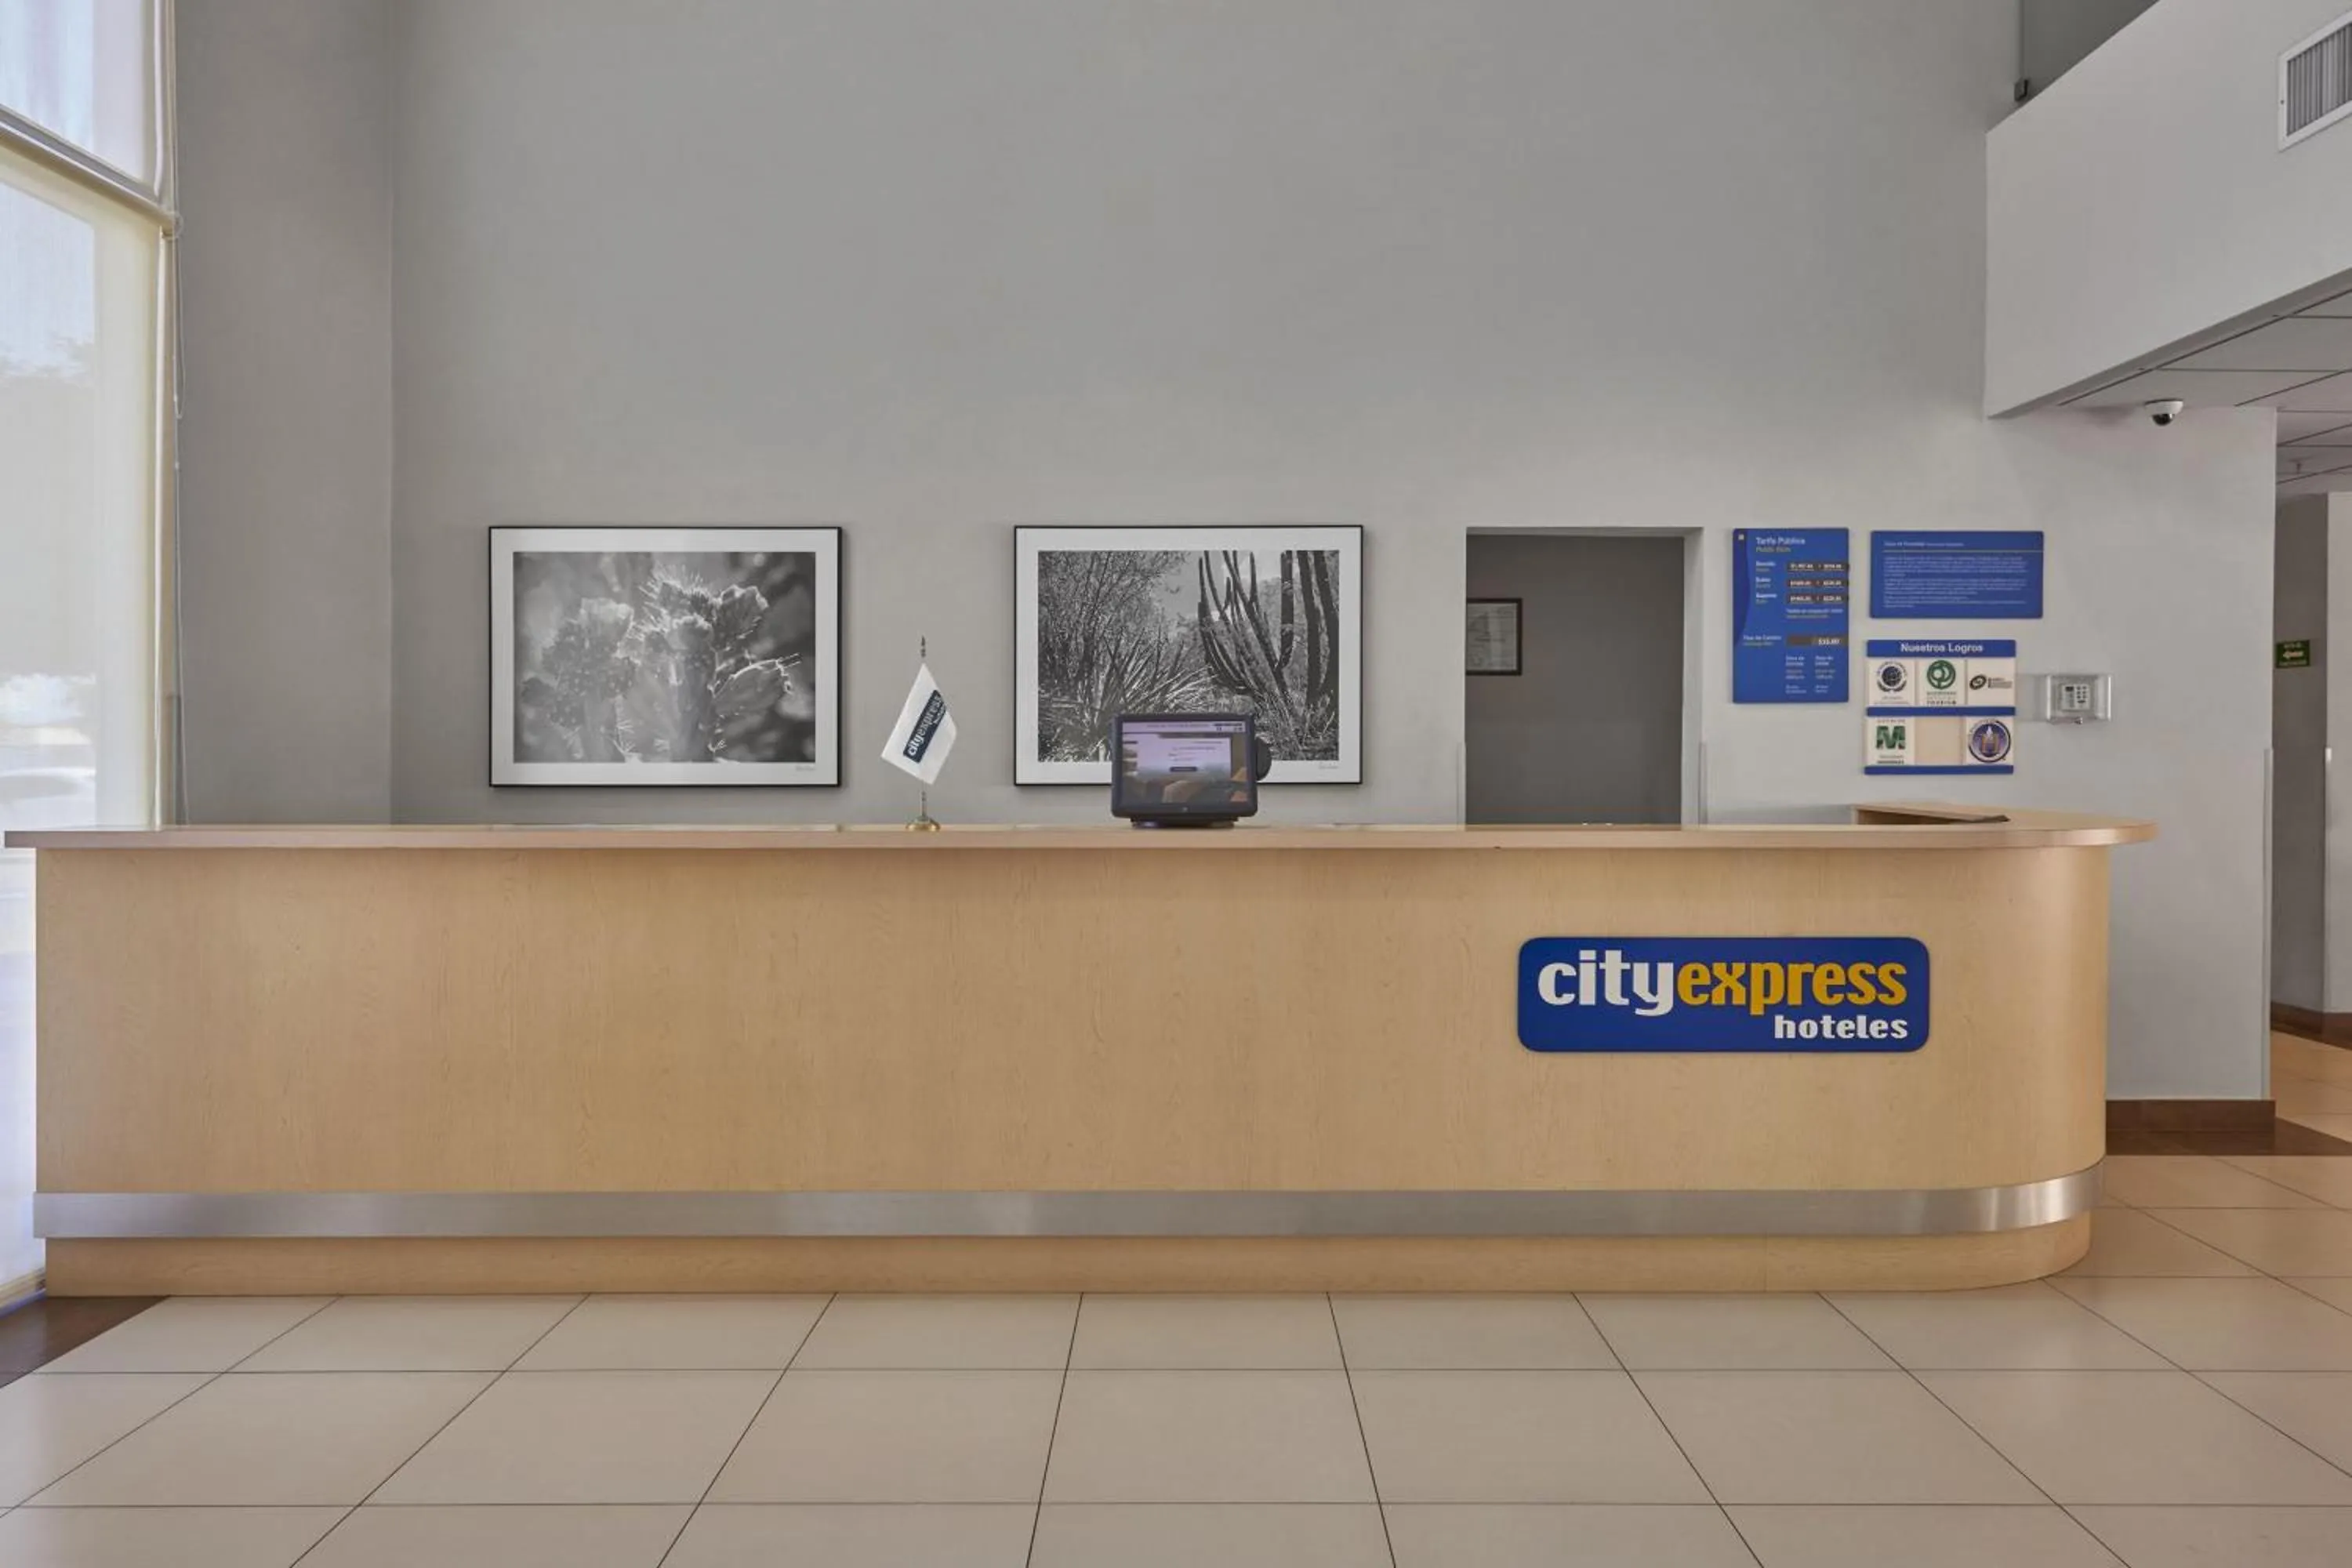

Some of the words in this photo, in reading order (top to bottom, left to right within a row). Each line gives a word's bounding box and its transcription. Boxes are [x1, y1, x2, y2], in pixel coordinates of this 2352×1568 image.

[1900, 643, 1945, 652] Nuestros
[1948, 643, 1984, 654] Logros
[1537, 949, 1907, 1017] cityexpress
[1774, 1014, 1908, 1040] hoteles
